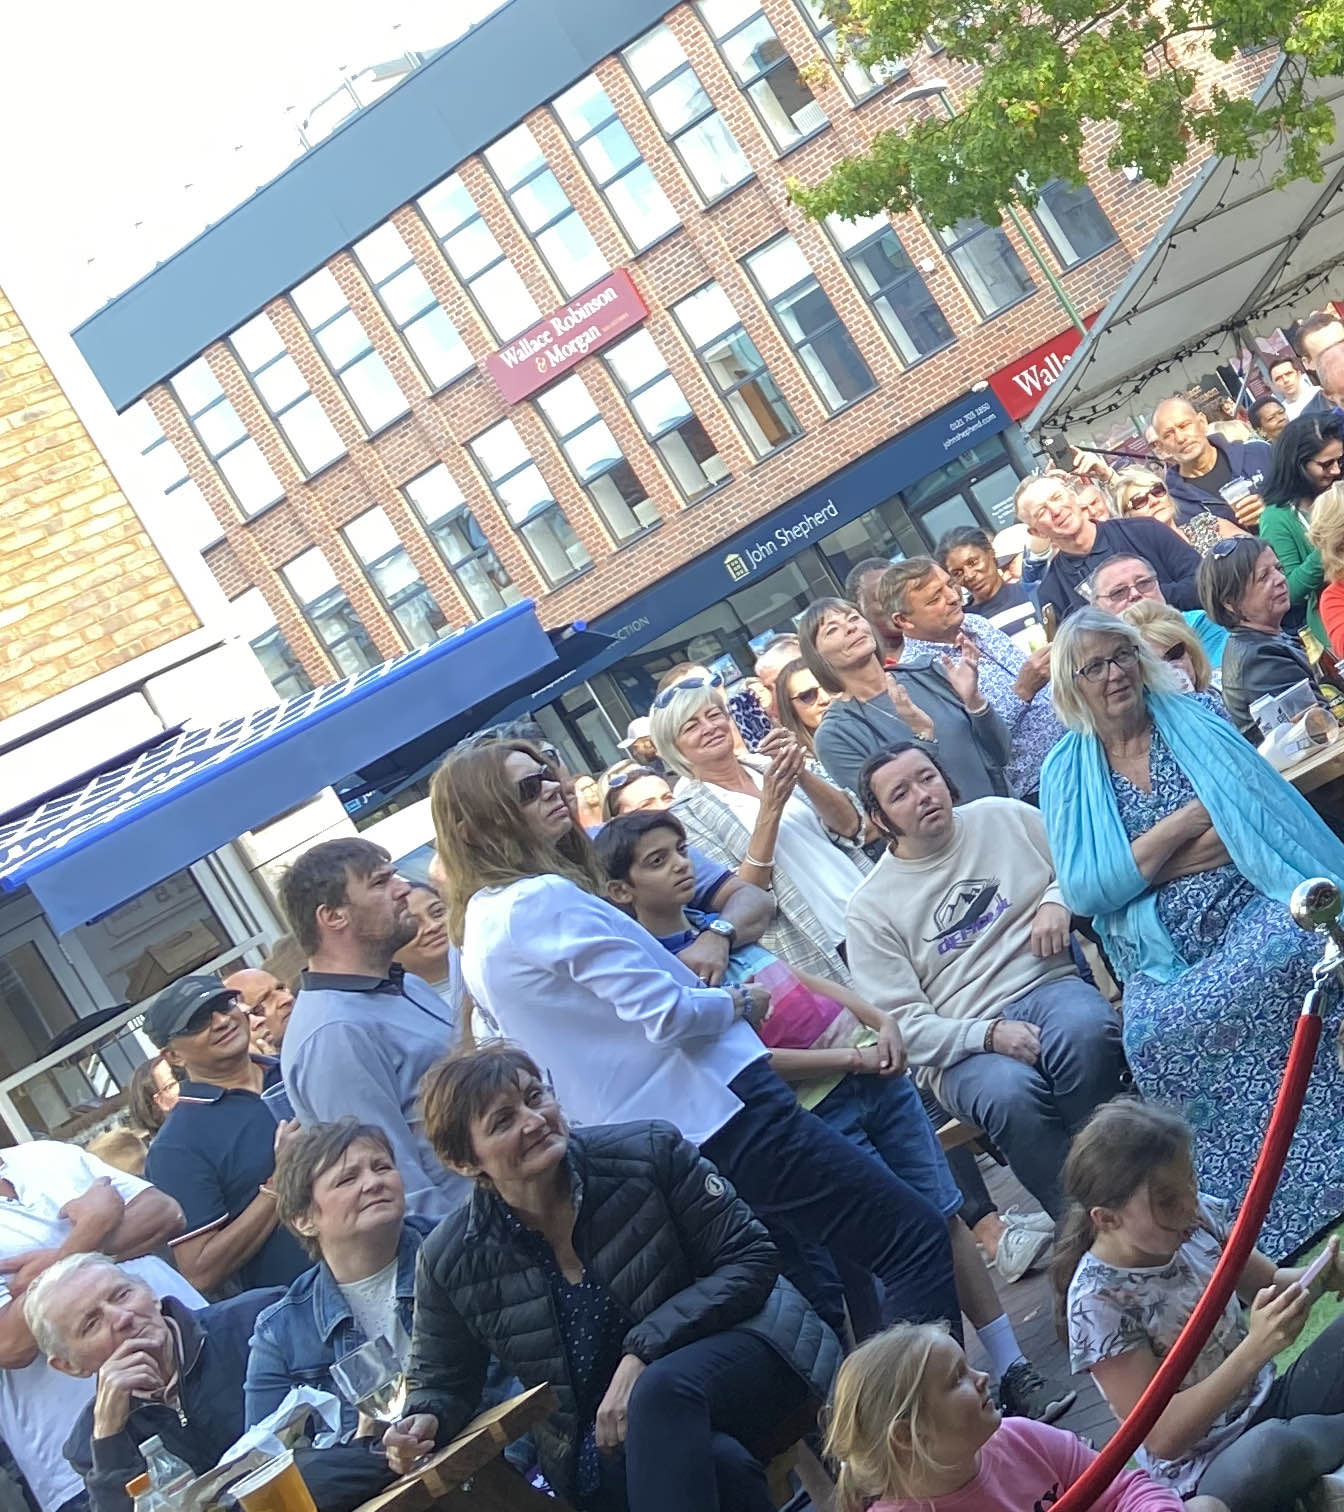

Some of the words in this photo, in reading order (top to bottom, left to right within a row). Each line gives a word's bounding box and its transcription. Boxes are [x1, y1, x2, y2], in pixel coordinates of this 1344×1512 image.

[499, 330, 554, 369] Wallace
[550, 287, 619, 337] Robinson
[544, 325, 602, 368] Morgan
[745, 542, 778, 570] John
[775, 499, 839, 547] Shepherd
